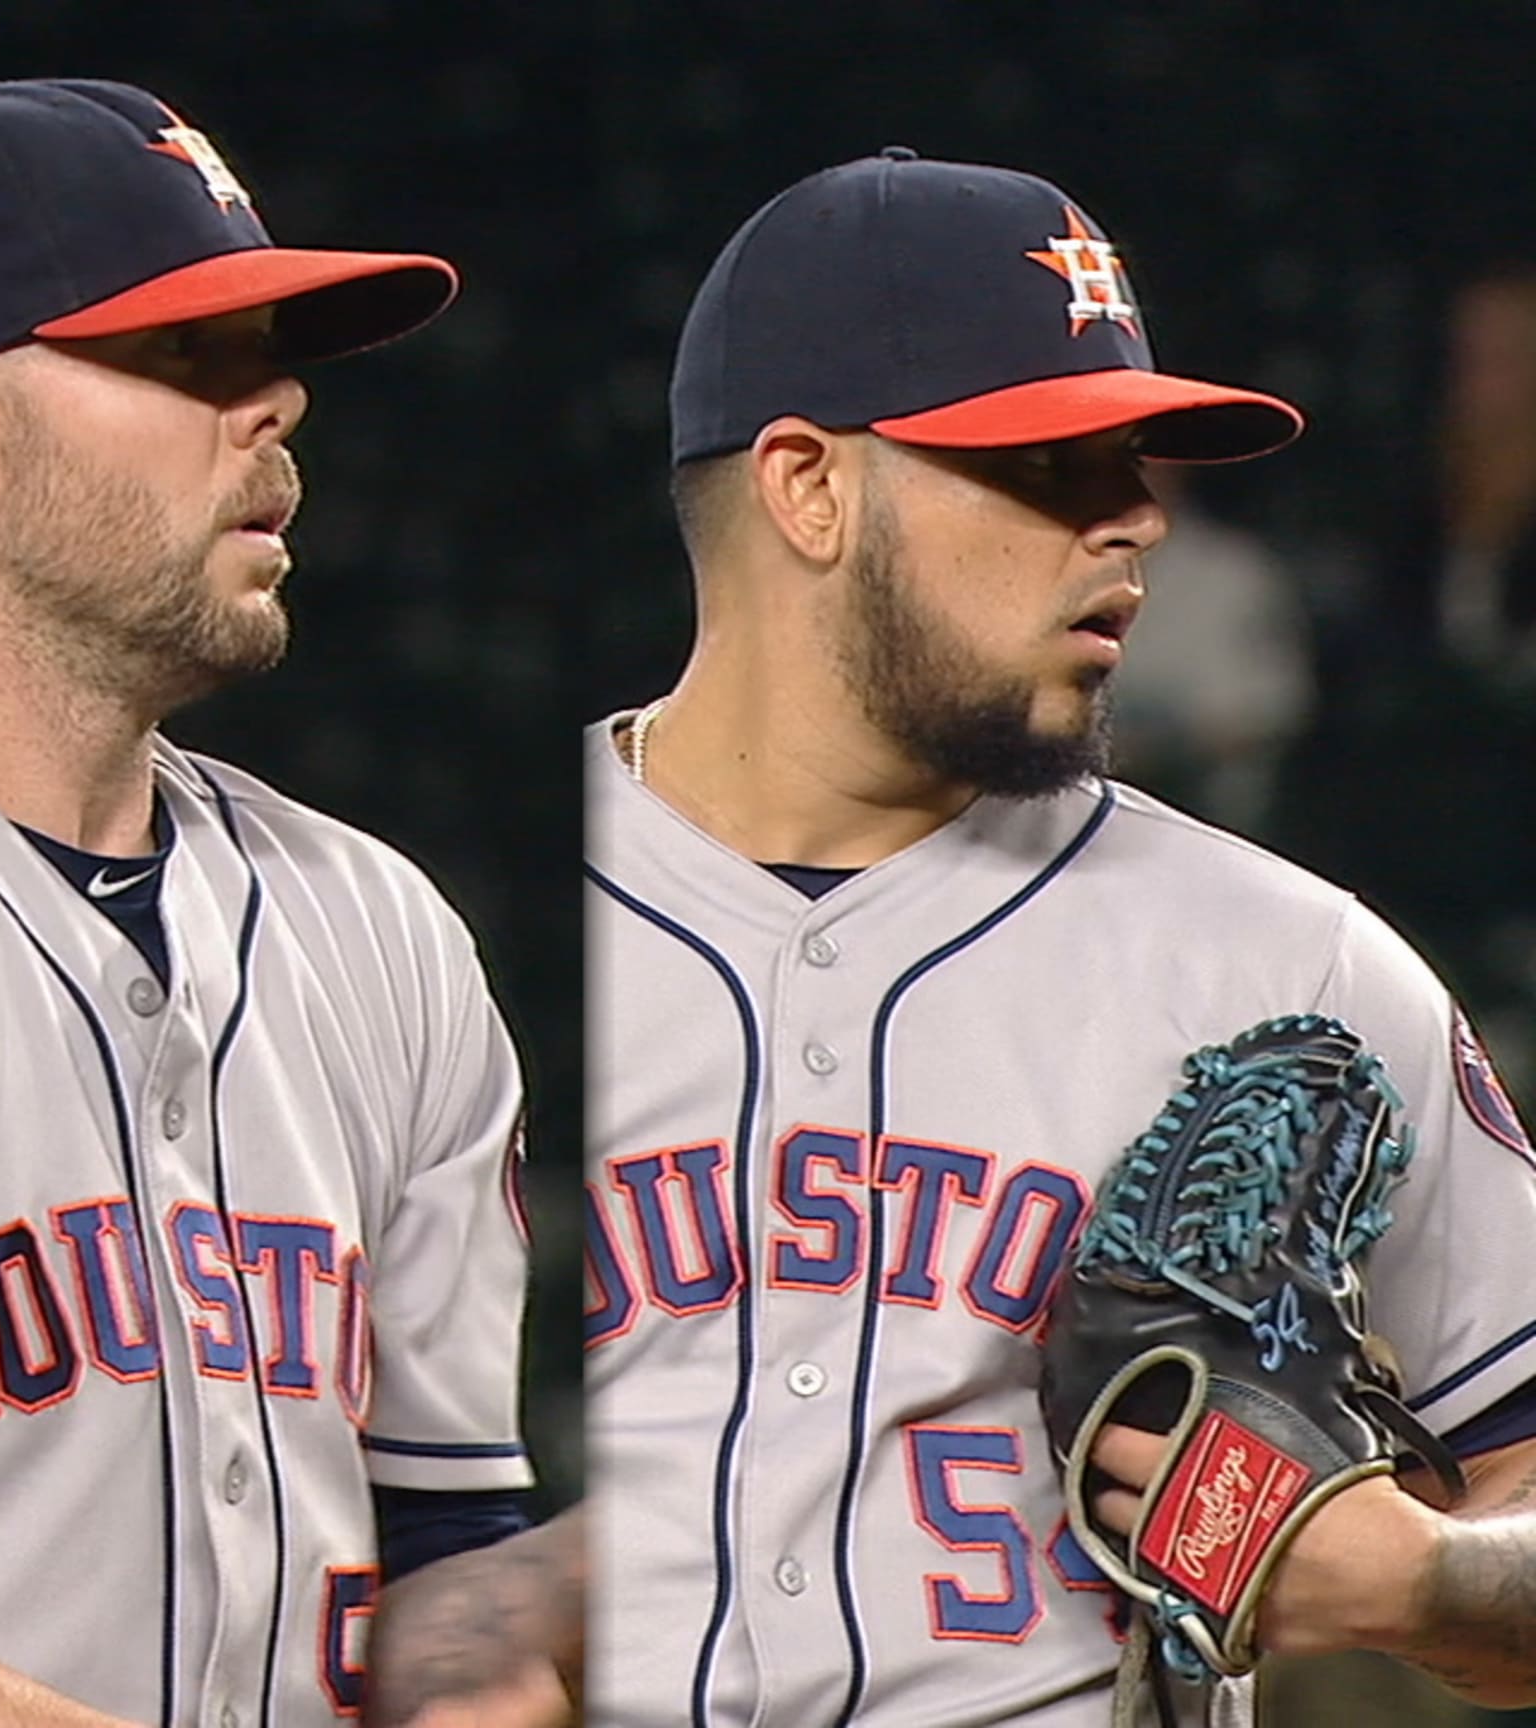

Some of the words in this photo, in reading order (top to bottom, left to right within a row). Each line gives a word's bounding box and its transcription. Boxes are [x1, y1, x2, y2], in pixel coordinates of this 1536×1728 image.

[1047, 236, 1134, 321] H
[584, 1122, 1095, 1348] USTO
[1175, 1444, 1256, 1581] Rawlings
